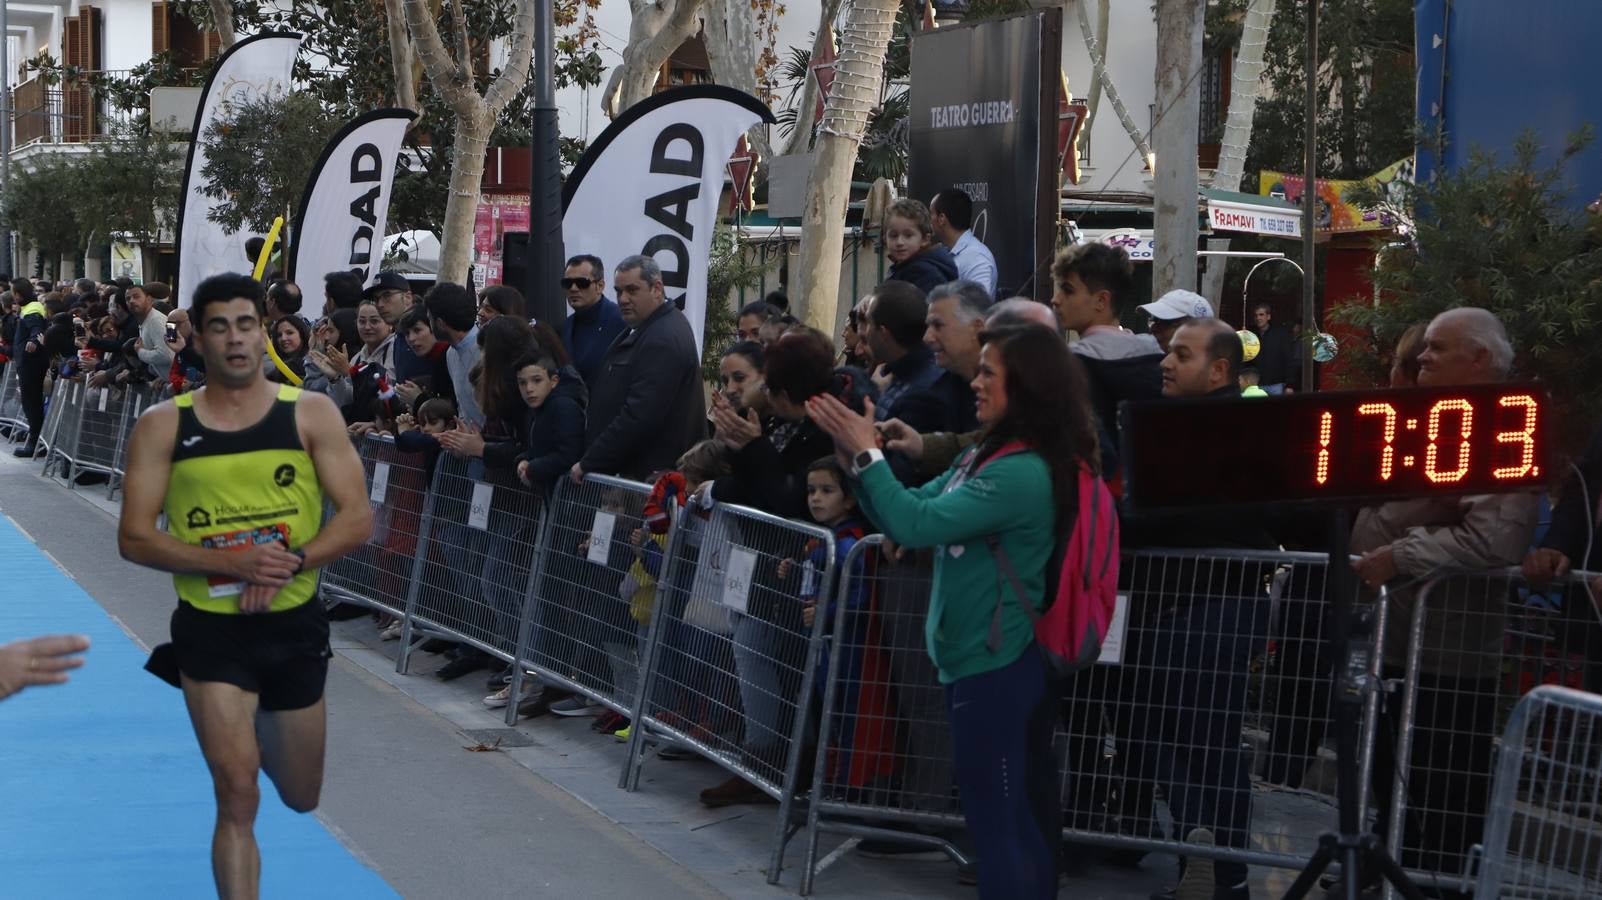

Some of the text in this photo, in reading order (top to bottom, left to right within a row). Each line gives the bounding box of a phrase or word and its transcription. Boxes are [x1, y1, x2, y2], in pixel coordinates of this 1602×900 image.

[930, 99, 1014, 128] TEATRO GUERRA
[640, 122, 704, 310] DAD
[1214, 208, 1255, 229] FRAMAVI
